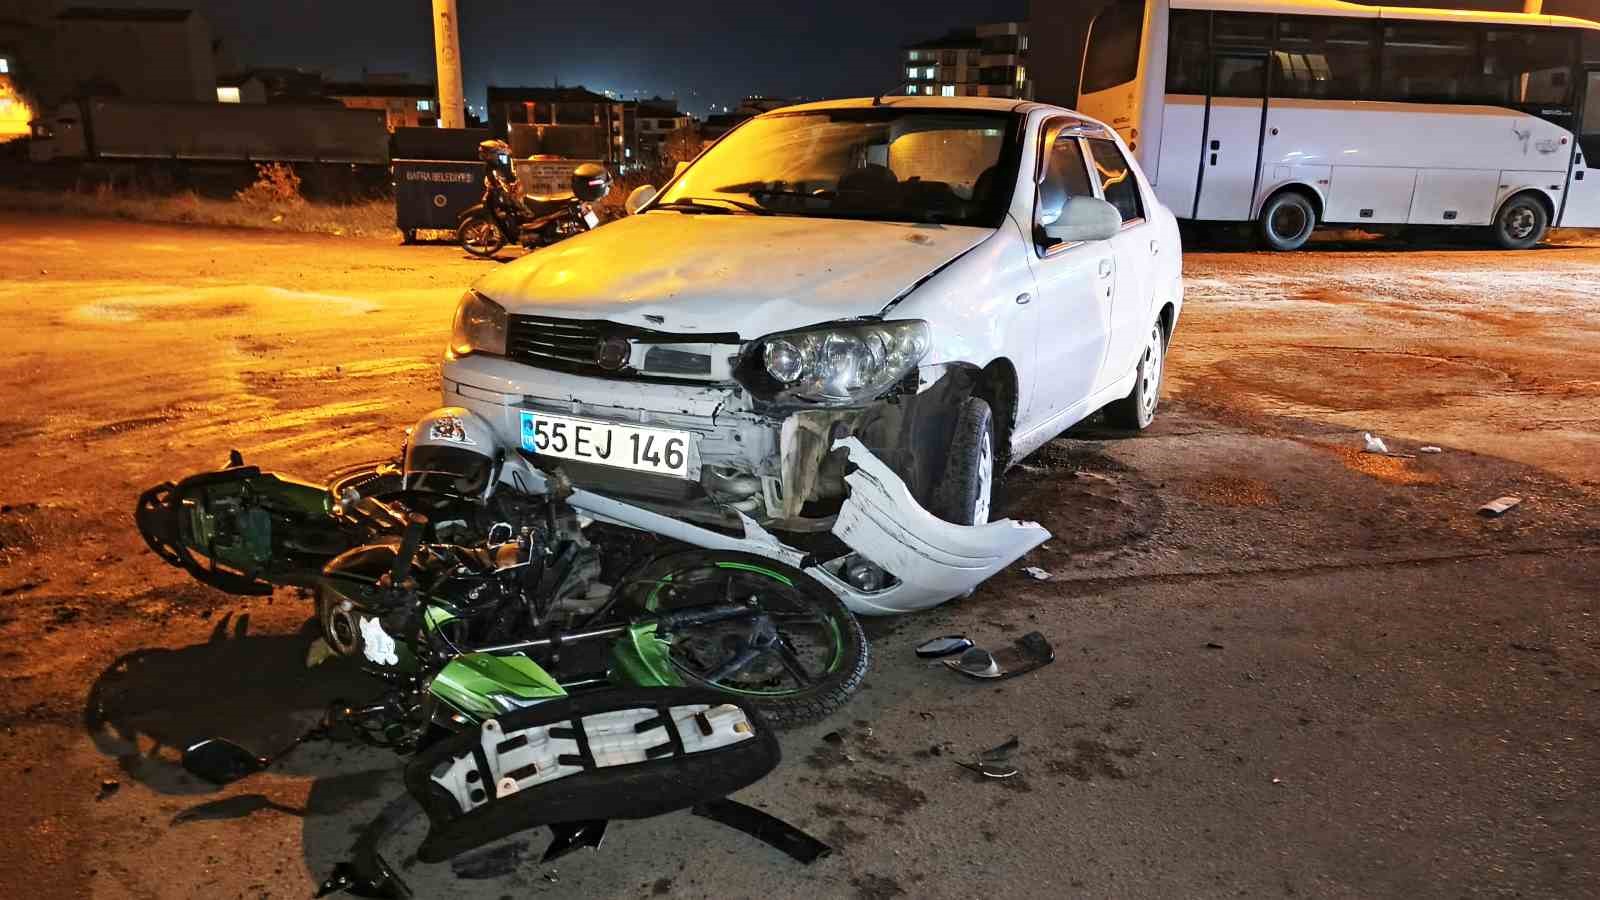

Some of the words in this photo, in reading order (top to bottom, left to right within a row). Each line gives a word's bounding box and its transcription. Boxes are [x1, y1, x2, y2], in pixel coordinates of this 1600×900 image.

[534, 420, 568, 453] 55
[575, 425, 612, 460] EJ
[629, 432, 685, 470] 146
